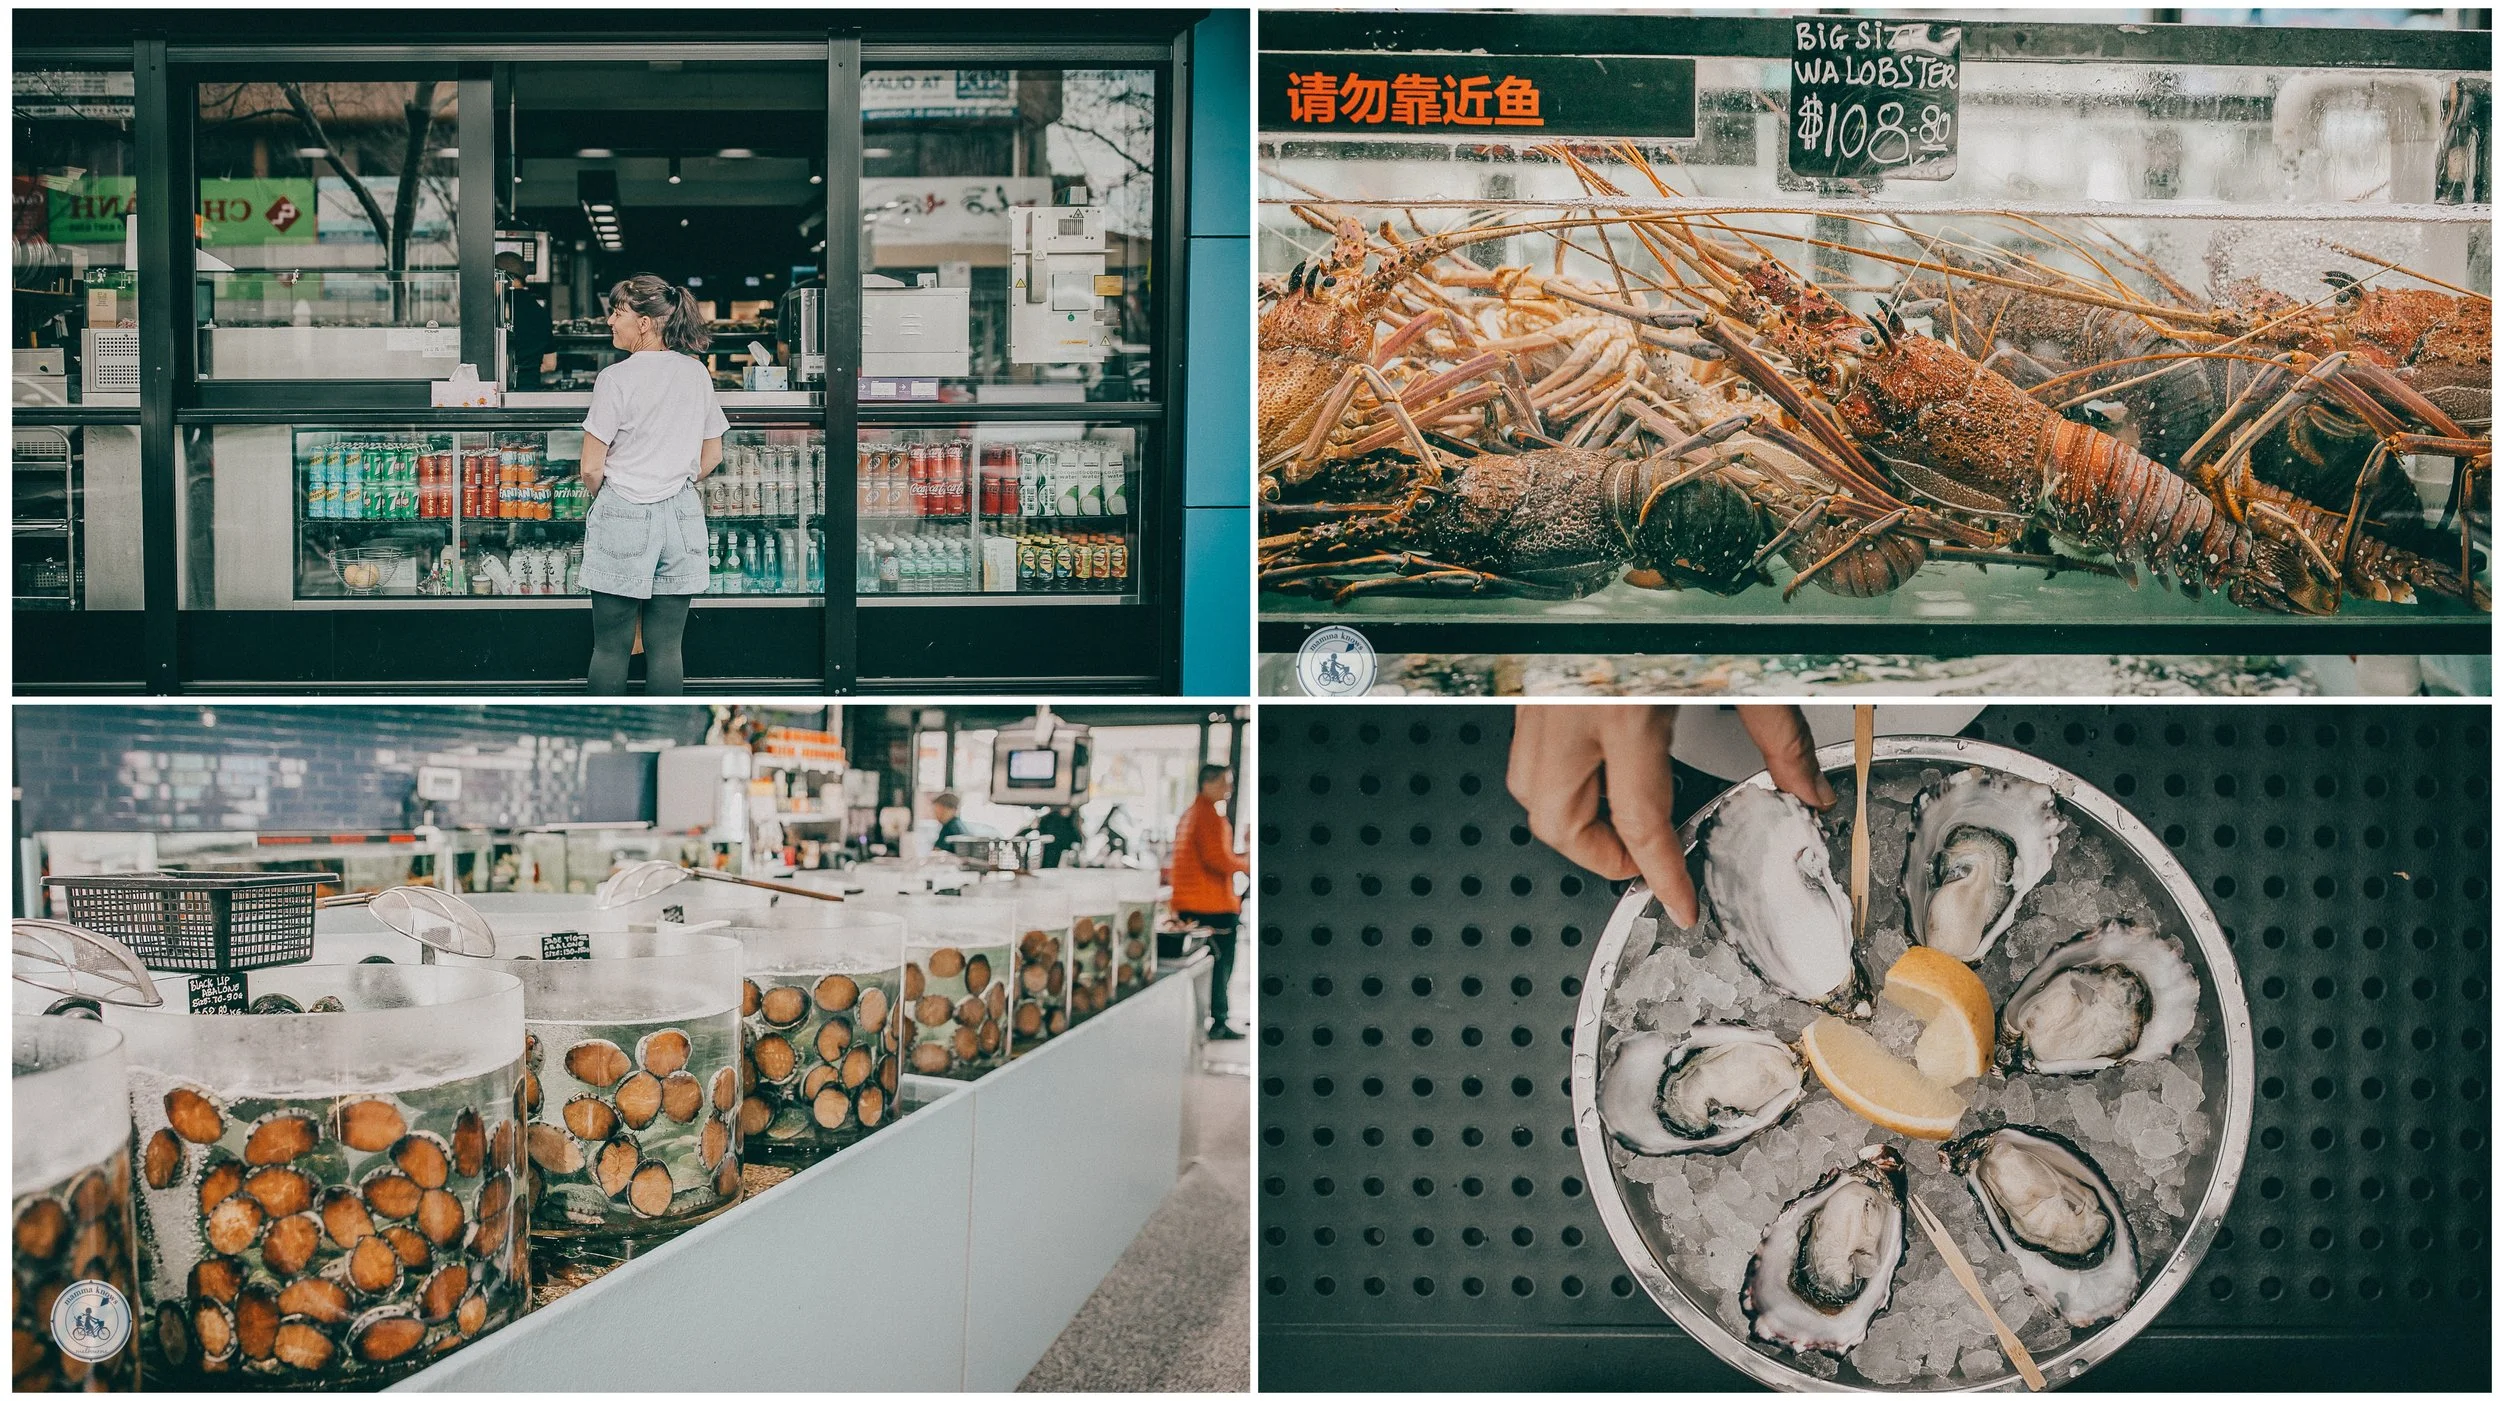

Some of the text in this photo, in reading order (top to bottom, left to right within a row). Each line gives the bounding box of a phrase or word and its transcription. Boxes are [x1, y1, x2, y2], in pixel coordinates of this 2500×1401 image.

[1794, 55, 1958, 89] WA LOBSTER
[1287, 71, 1545, 126] 请勿靠近鱼
[190, 976, 230, 992] BLACK LIP
